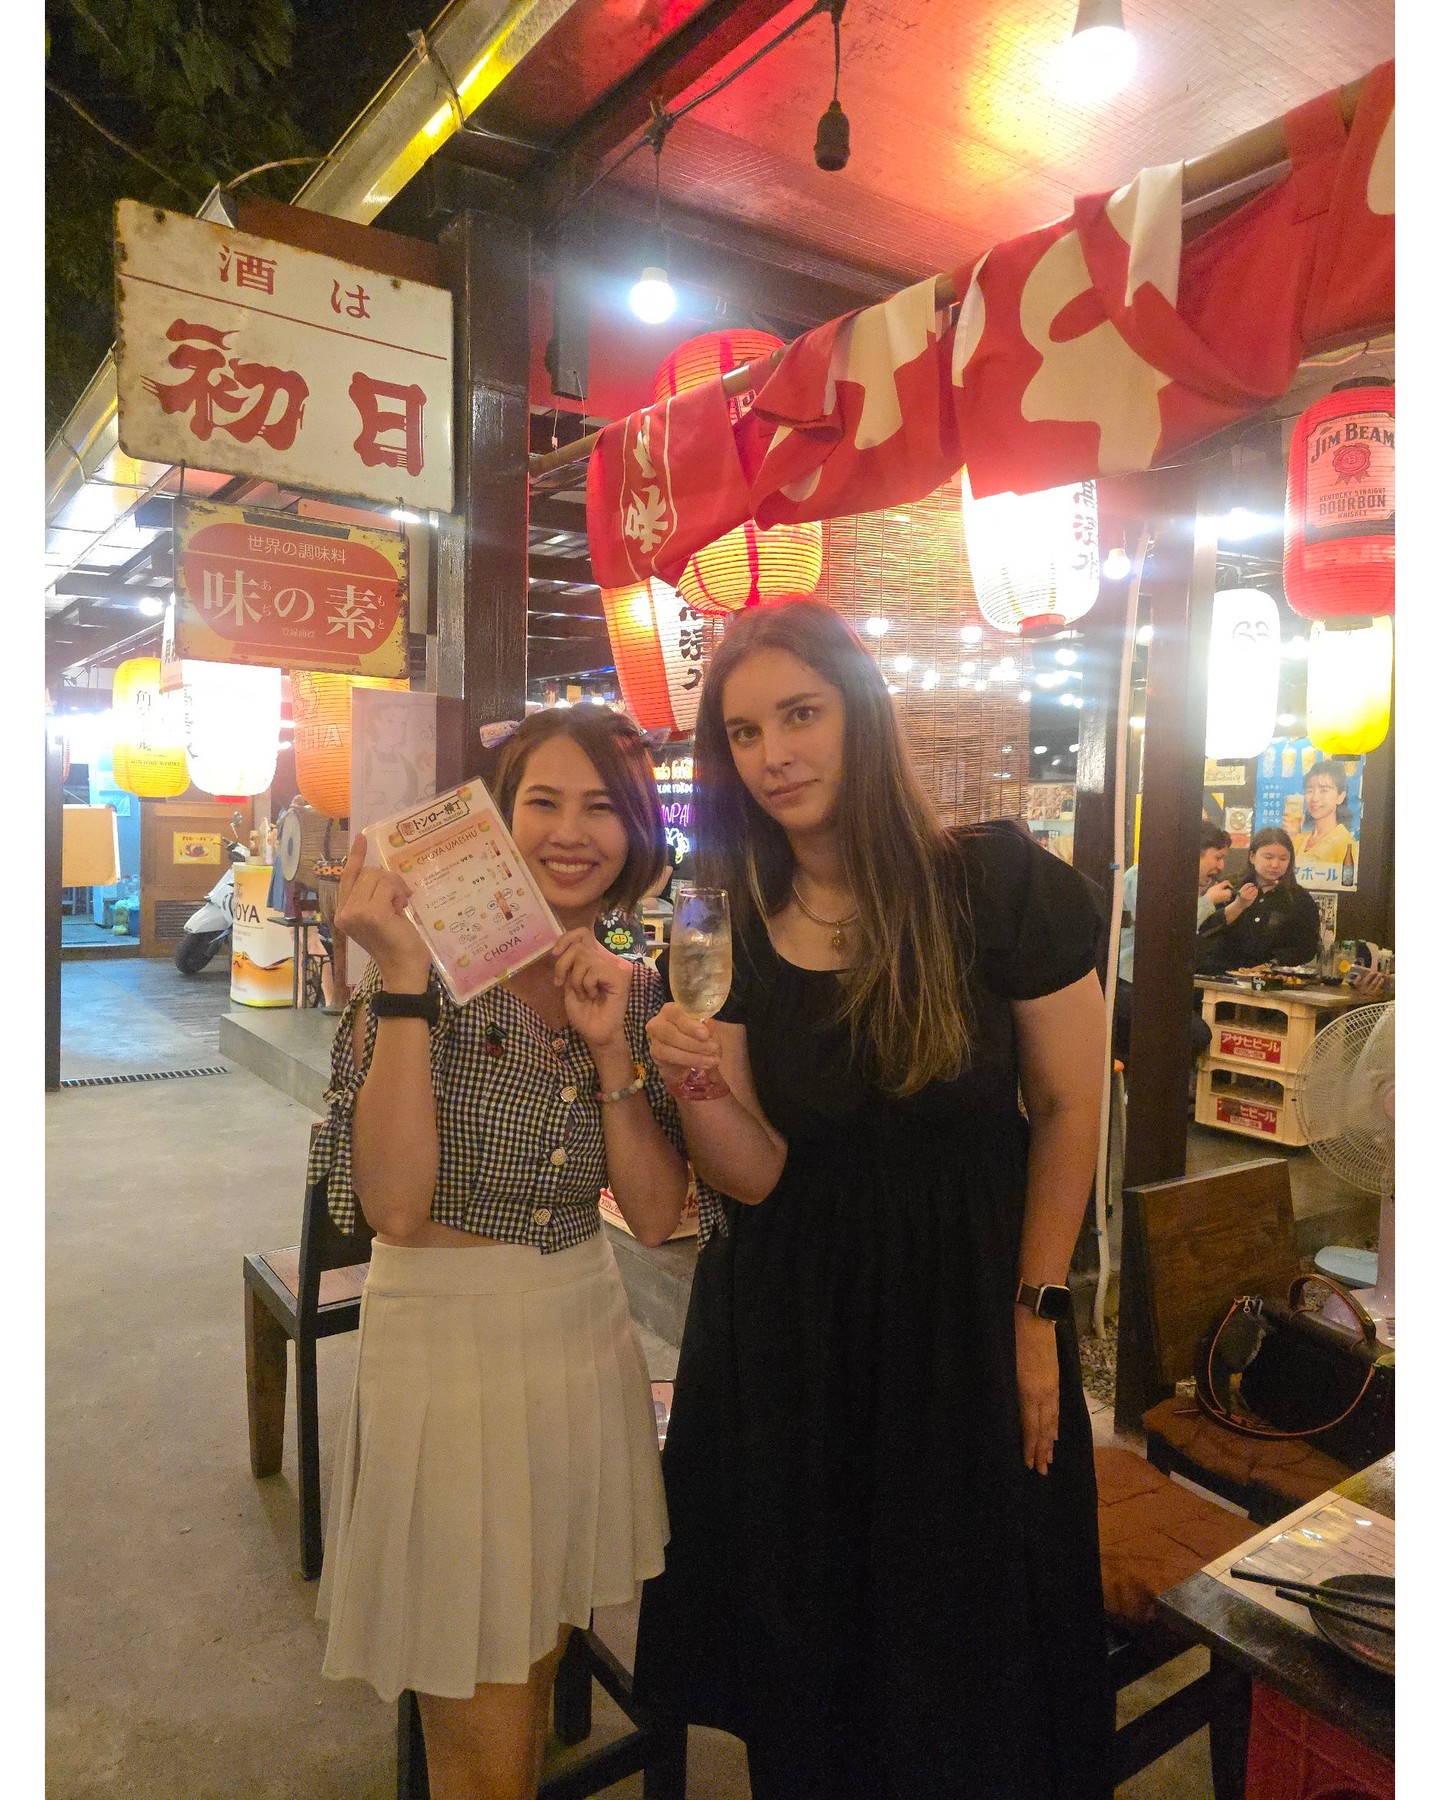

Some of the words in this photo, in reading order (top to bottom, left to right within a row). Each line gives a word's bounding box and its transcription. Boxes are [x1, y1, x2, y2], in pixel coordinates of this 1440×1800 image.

[218, 245, 371, 320] 酒は
[140, 318, 427, 477] 初日
[1310, 426, 1342, 464] JIM
[1345, 422, 1395, 451] BEAM
[1320, 494, 1386, 516] BOURBON
[1354, 486, 1386, 498] STRAIGHT
[1337, 509, 1368, 520] WHISKEY
[247, 534, 347, 565] 世界の調味料
[203, 569, 378, 640] 味の素
[444, 828, 478, 852] UMESHU
[484, 935, 522, 962] CHOYA
[1222, 1032, 1280, 1053] アサヒビール
